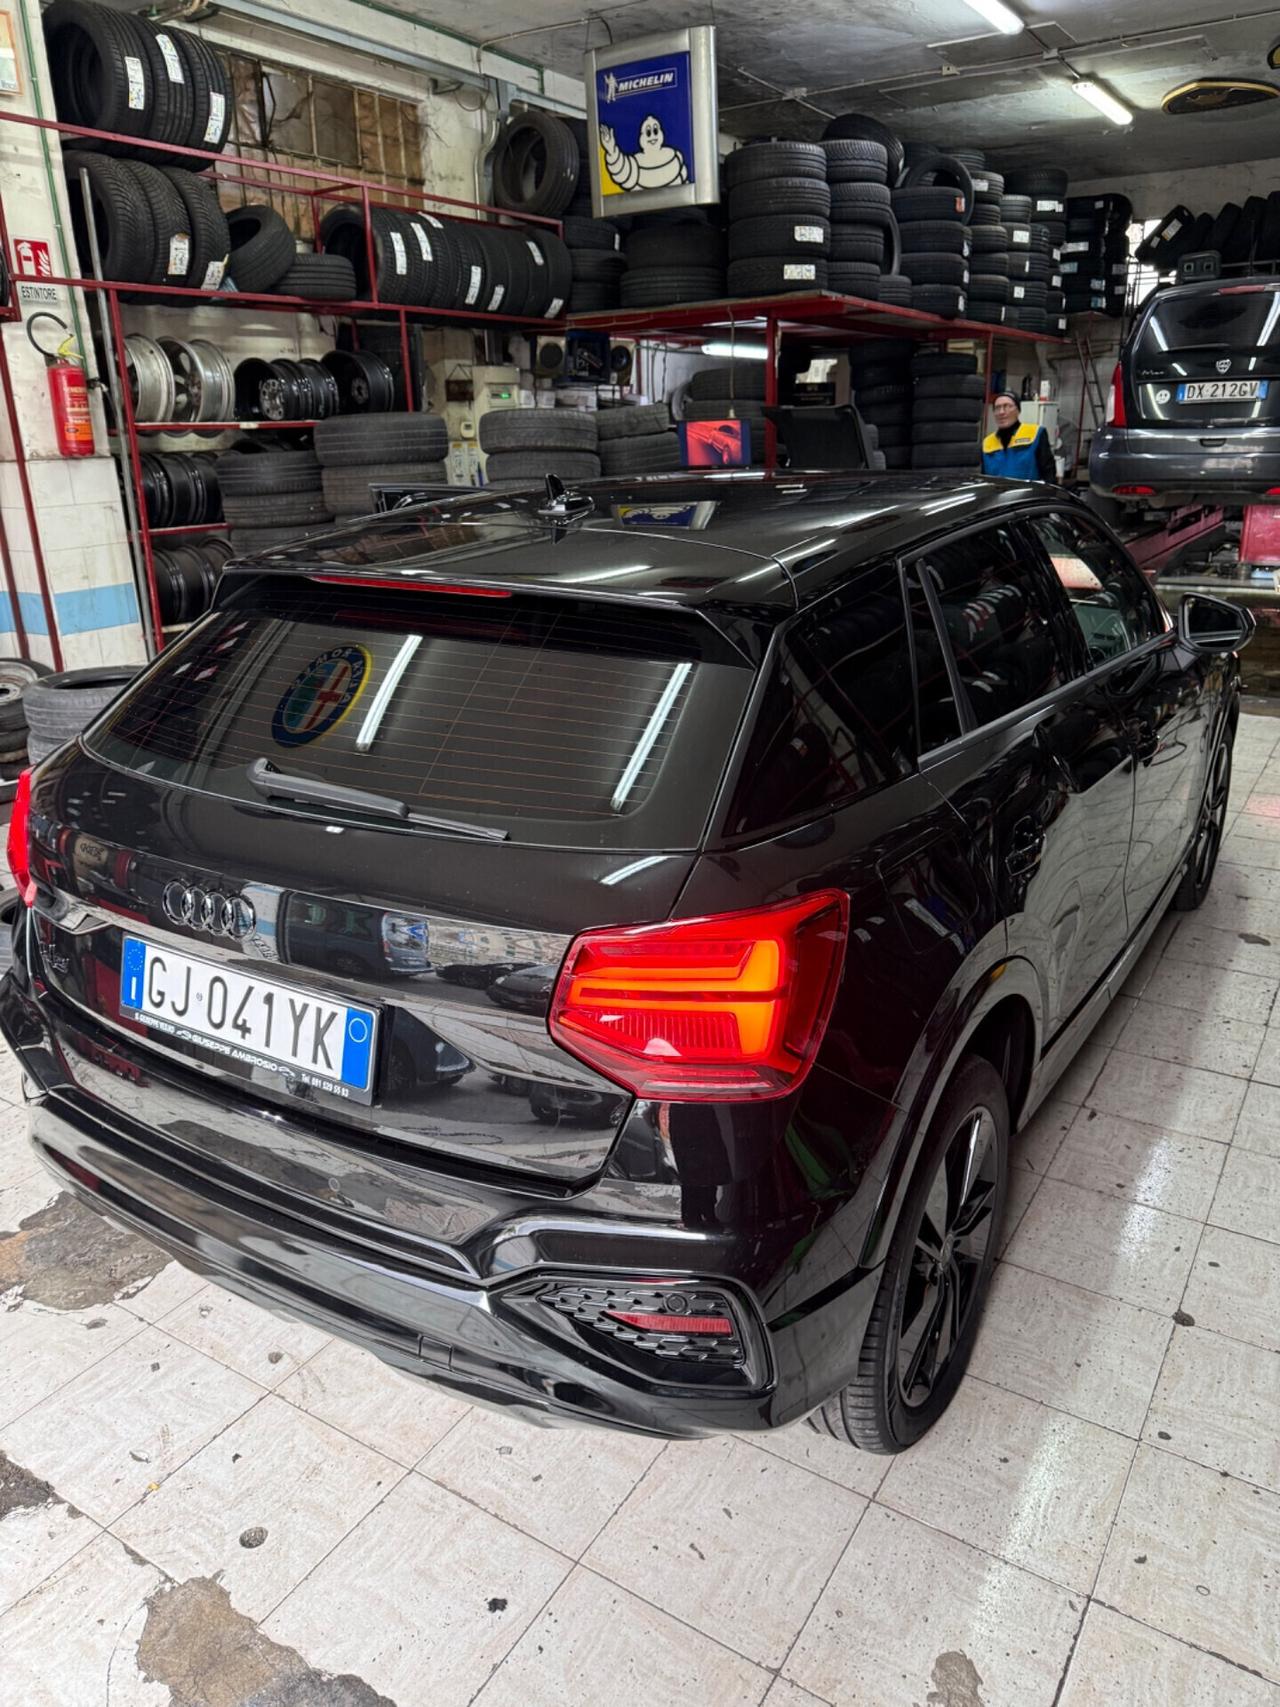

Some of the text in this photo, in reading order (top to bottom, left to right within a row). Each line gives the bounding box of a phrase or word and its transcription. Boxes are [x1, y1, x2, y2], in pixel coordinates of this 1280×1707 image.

[617, 72, 674, 92] MICHELIN
[21, 285, 57, 300] ESTINTORE
[1187, 382, 1258, 399] DX 212GV
[148, 956, 339, 1071] GJ 041YK
[231, 1049, 278, 1072] AMBROSIO
